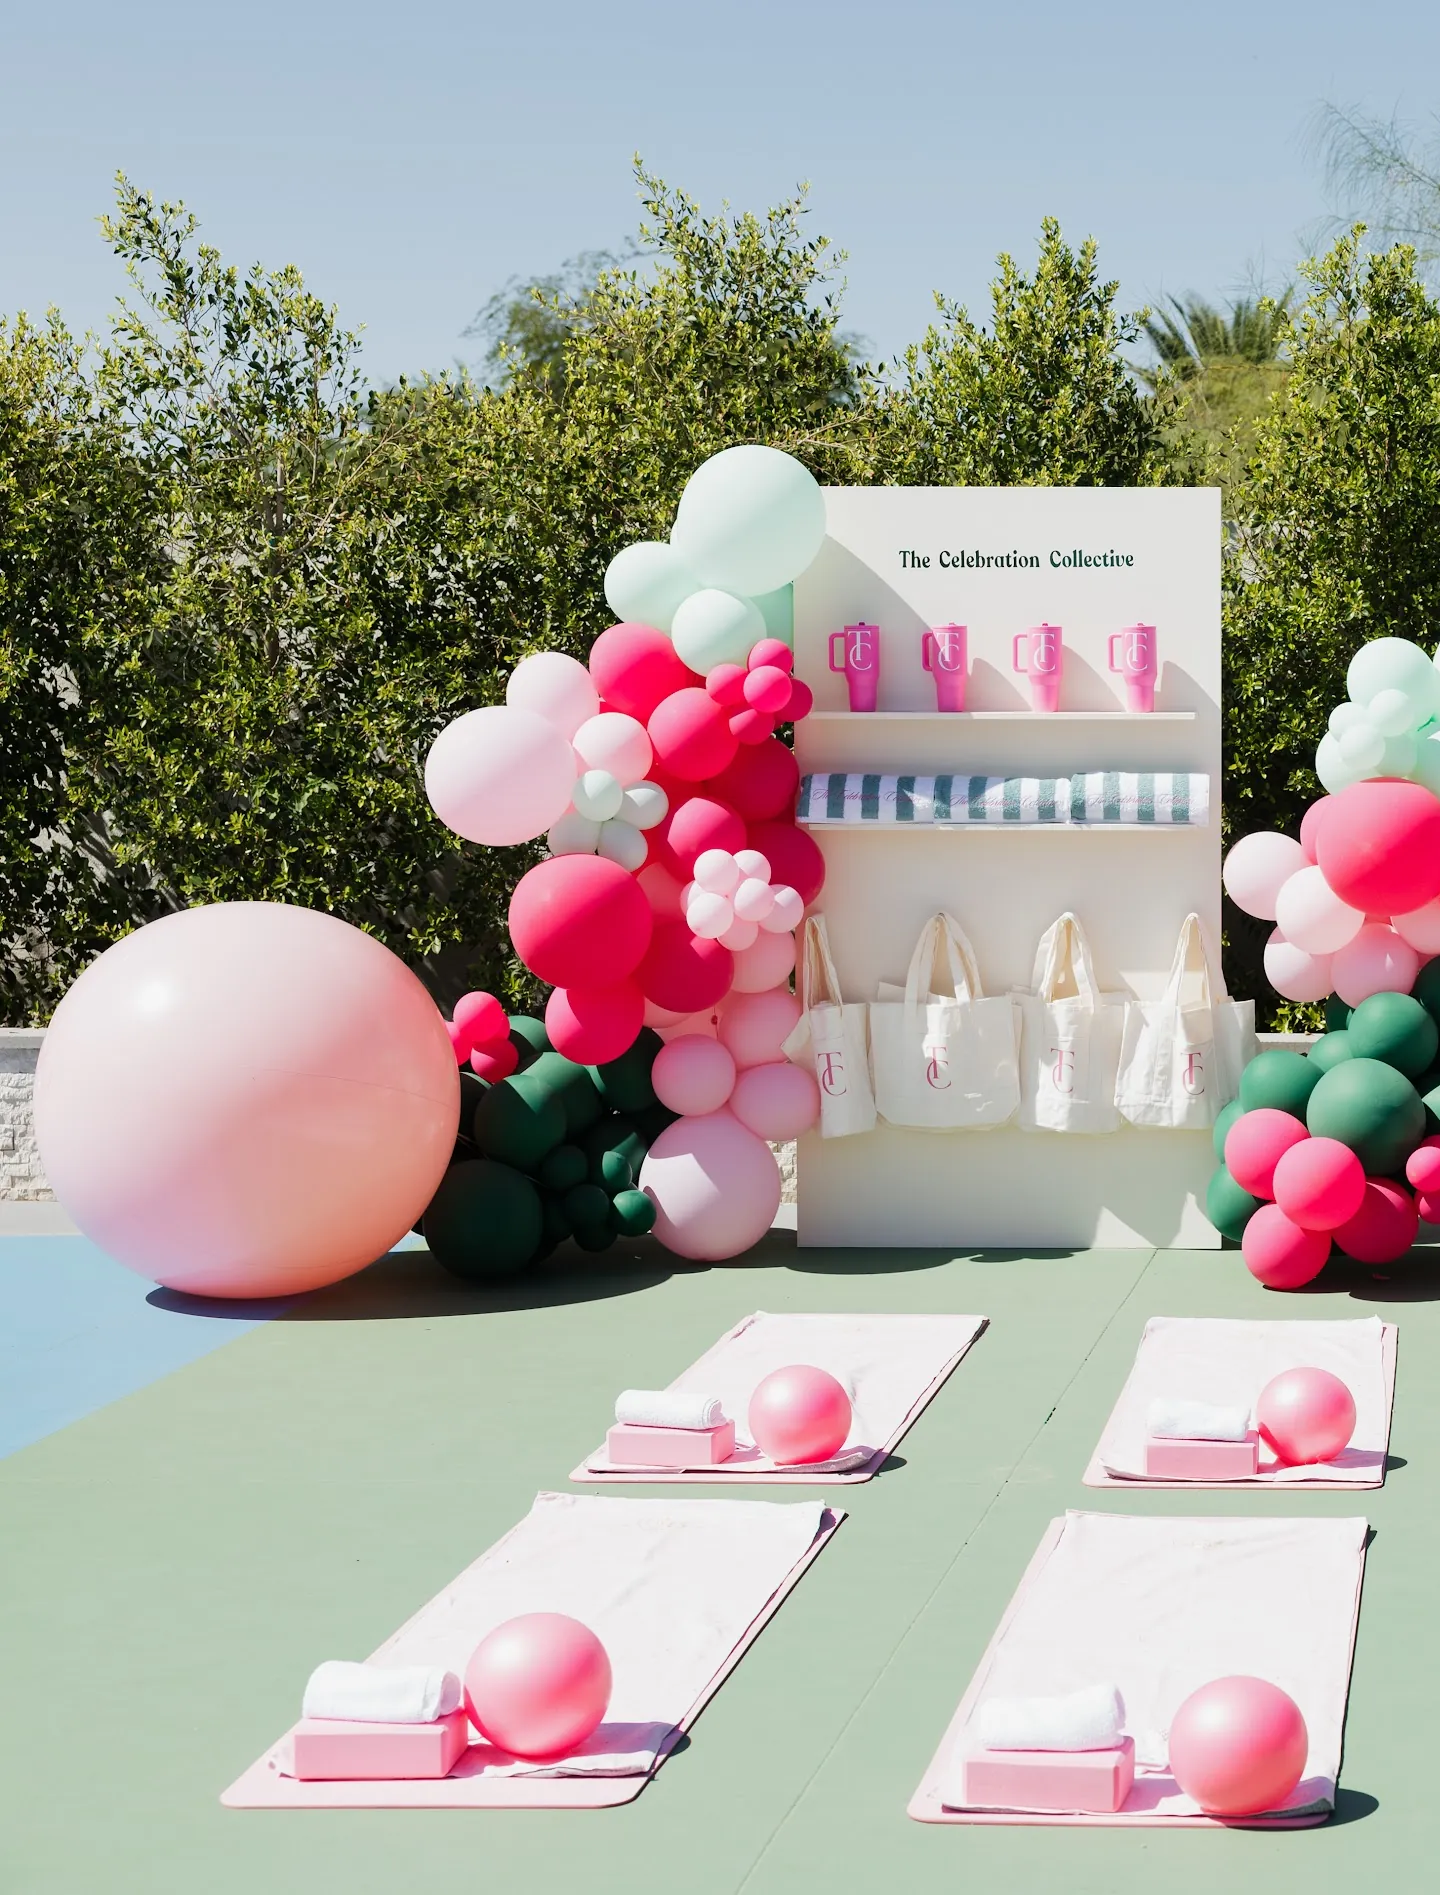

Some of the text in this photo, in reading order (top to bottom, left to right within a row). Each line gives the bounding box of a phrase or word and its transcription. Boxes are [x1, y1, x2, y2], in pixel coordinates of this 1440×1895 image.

[899, 549, 1135, 569] The Celebration Collective
